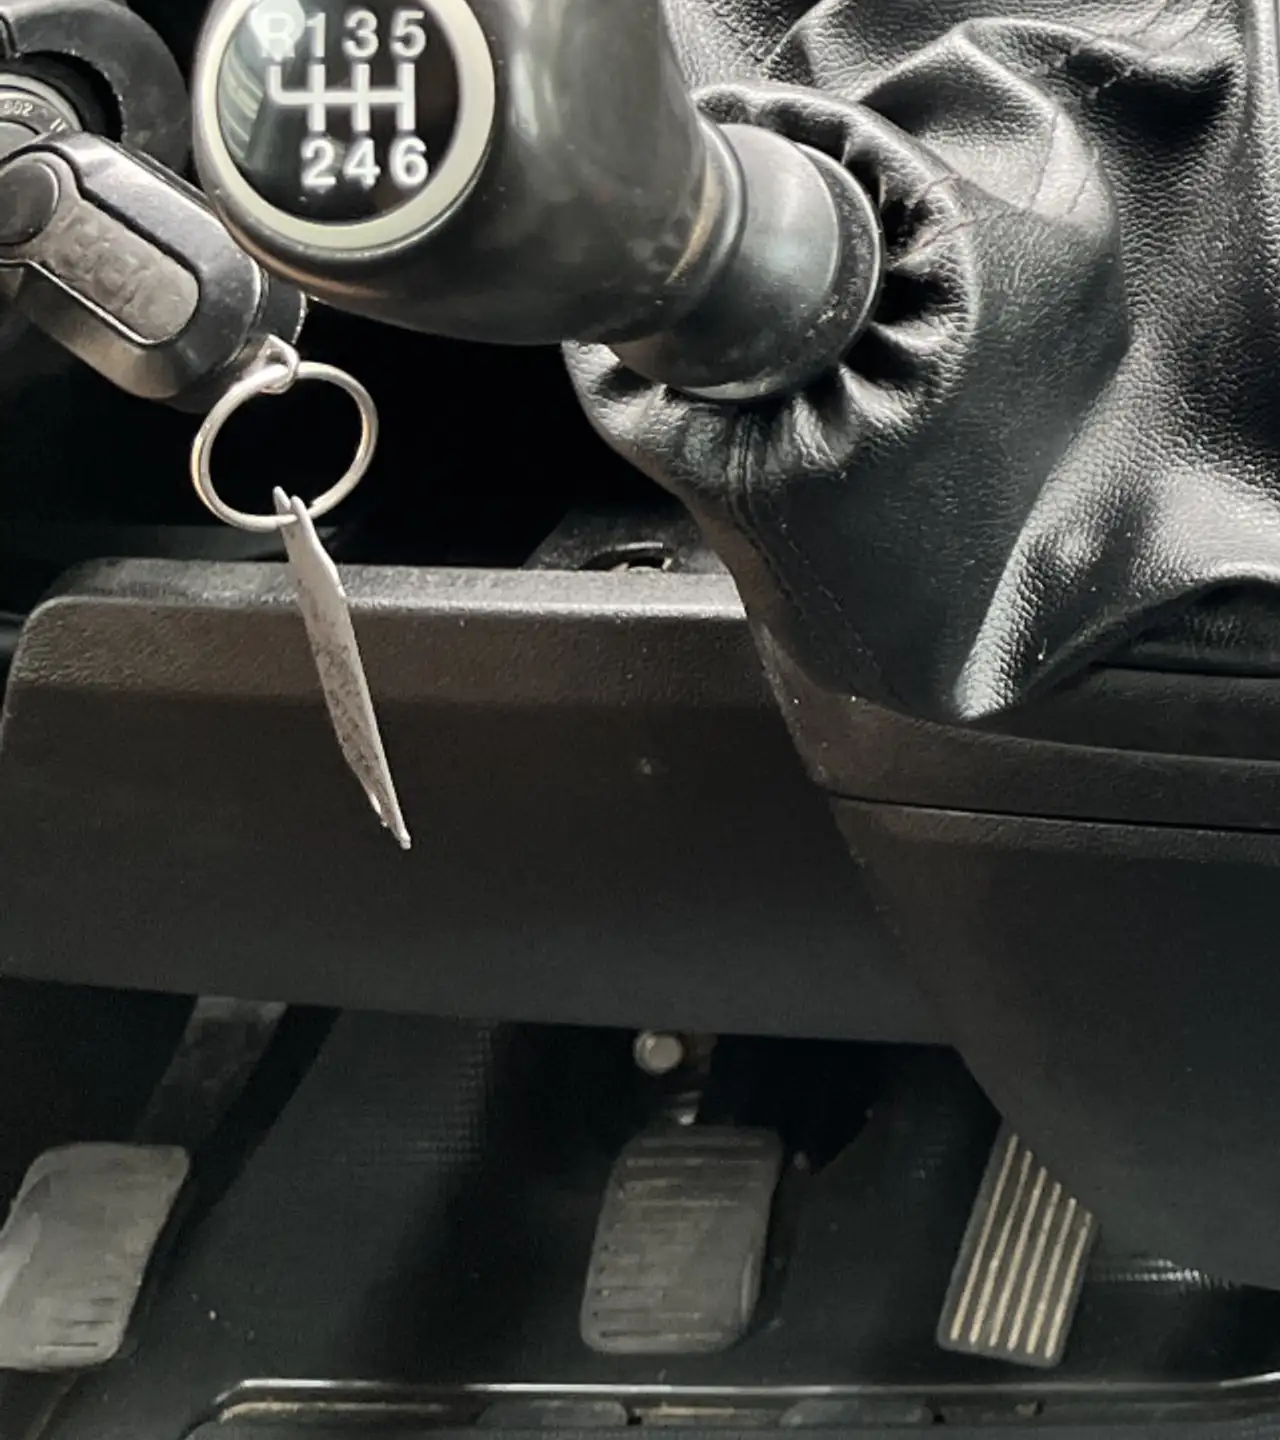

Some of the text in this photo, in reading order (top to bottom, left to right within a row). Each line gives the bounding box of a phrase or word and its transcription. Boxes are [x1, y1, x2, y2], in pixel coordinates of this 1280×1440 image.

[305, 10, 327, 58] 1
[343, 8, 380, 59] 3
[391, 9, 428, 58] 5
[302, 135, 430, 188] 2 4 6
